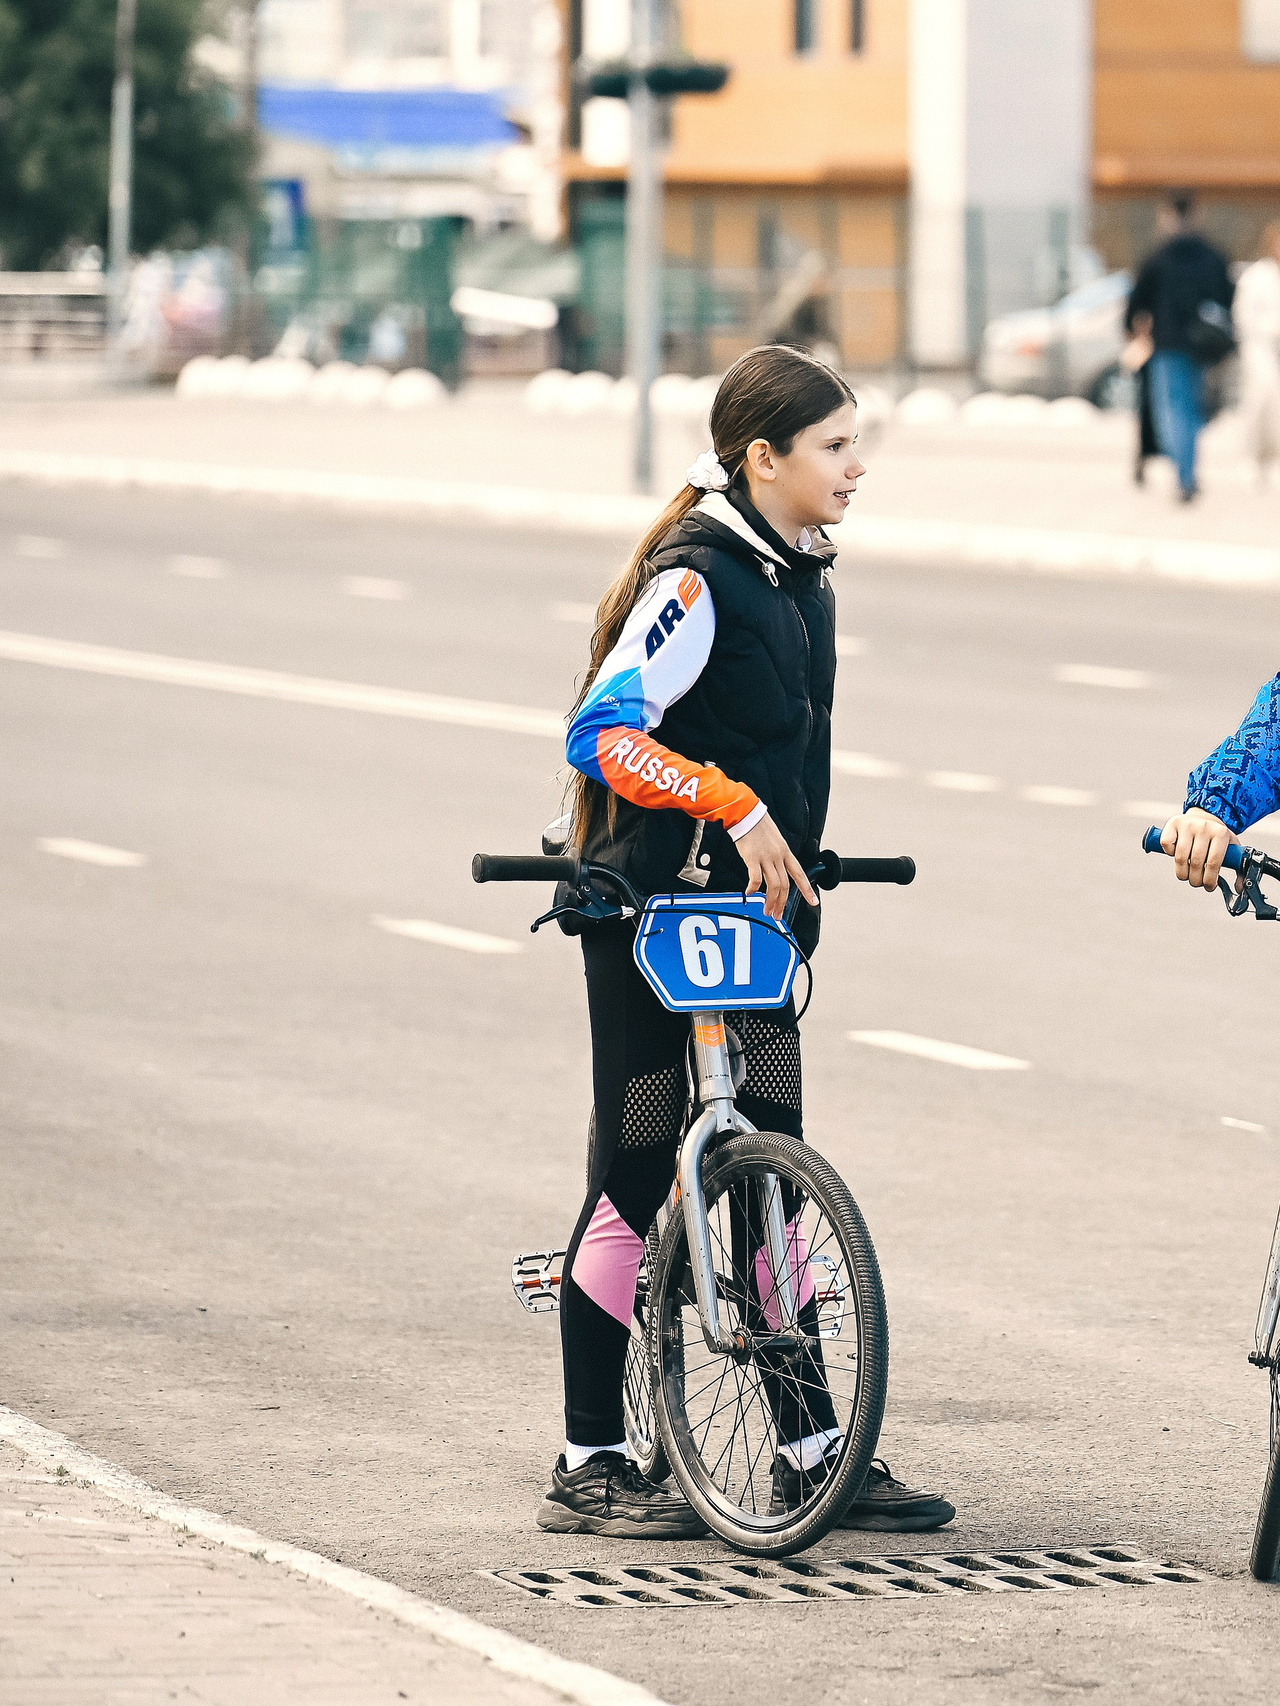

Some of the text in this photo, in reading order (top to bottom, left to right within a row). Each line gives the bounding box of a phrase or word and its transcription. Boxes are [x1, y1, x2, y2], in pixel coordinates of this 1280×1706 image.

[608, 737, 700, 803] RUSSIA
[679, 915, 751, 988] 67
[651, 1305, 659, 1367] KENDA
